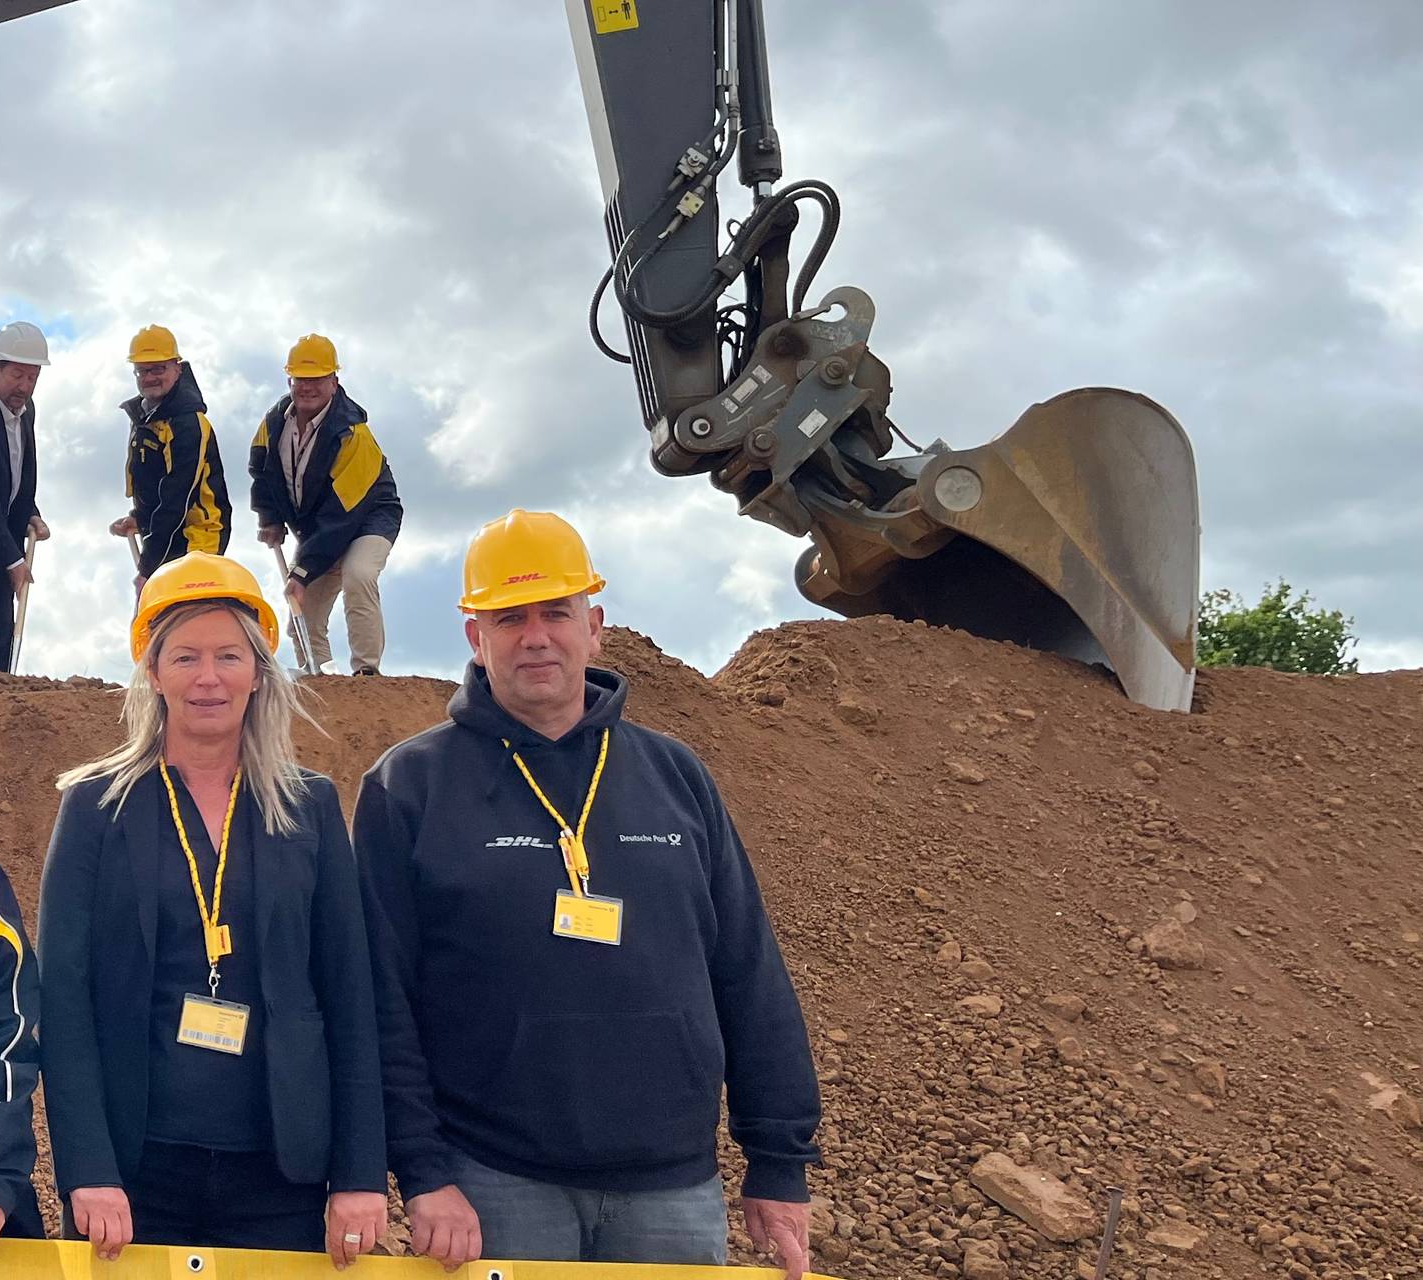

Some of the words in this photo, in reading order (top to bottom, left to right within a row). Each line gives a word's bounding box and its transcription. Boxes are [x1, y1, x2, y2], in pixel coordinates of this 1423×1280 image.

[505, 573, 544, 585] DHL
[491, 836, 549, 849] DHL
[619, 834, 652, 842] Deutsche
[652, 835, 667, 843] Post
